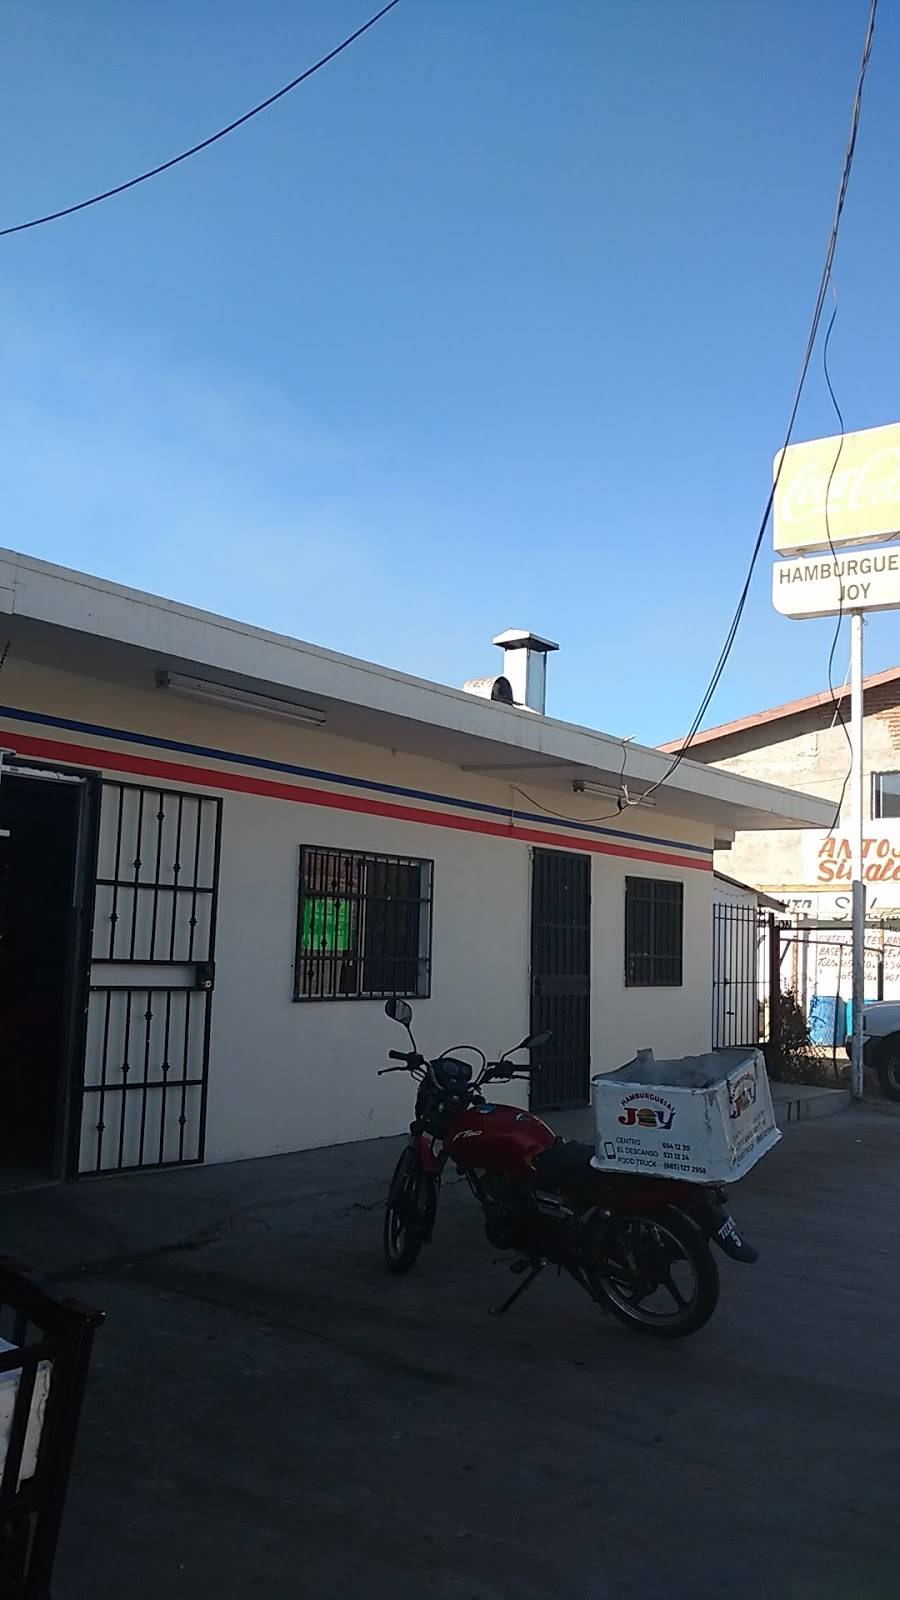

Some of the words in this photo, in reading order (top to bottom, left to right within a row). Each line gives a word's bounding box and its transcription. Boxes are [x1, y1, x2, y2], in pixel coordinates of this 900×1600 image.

[779, 555, 899, 584] HAMBURGUE
[838, 582, 871, 602] JOY
[620, 1092, 676, 1112] HAMBURGUESAS
[618, 1107, 677, 1130] JOY
[616, 1137, 641, 1145] CENTRO
[618, 1156, 635, 1165] FOOD
[636, 1158, 657, 1167] TRUCK
[625, 1147, 659, 1157] DESCANSO
